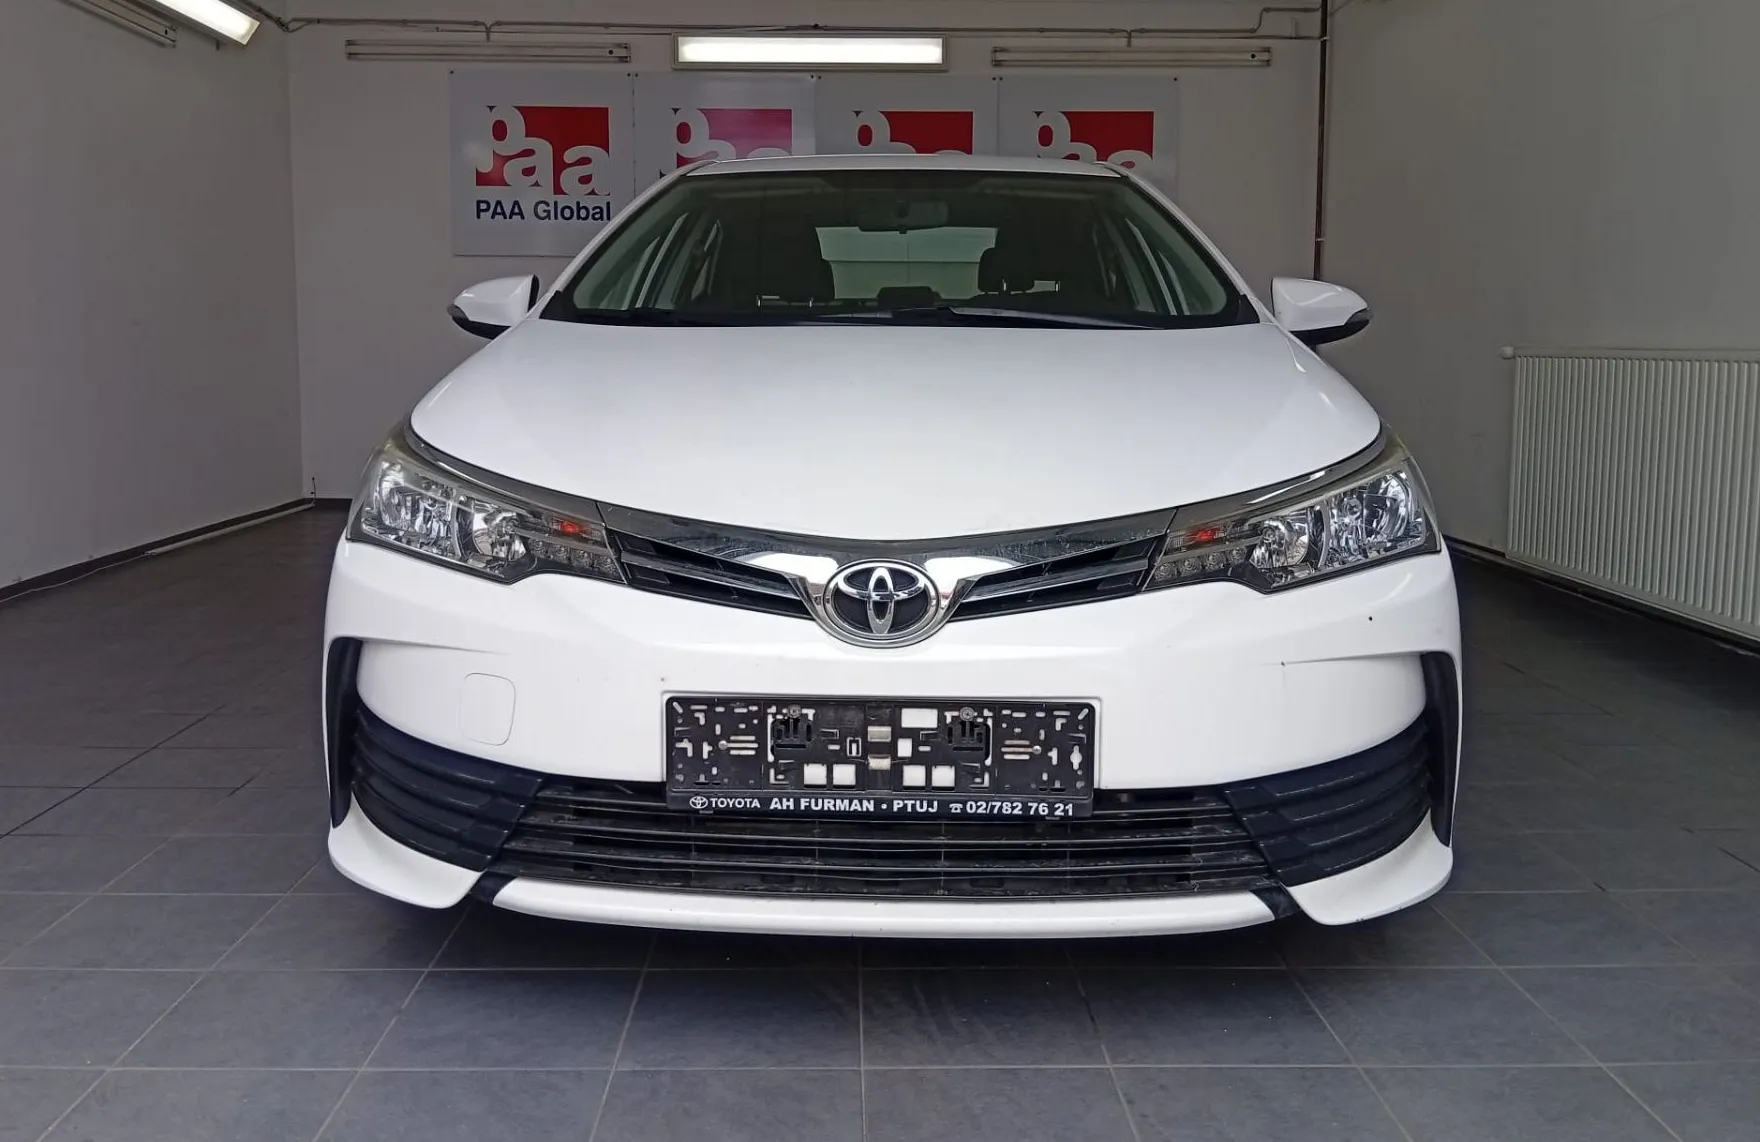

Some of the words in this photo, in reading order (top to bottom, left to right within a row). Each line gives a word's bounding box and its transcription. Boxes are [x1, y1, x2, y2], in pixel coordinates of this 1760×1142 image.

[476, 200, 525, 220] PAA
[533, 200, 611, 221] Global
[710, 797, 761, 809] TOYOTA
[769, 797, 795, 810] AH
[800, 798, 875, 812] FURMAN
[893, 799, 938, 813] PTUJ
[966, 800, 1023, 815] 02/782
[1027, 801, 1049, 816] 76
[1053, 802, 1073, 817] 21
